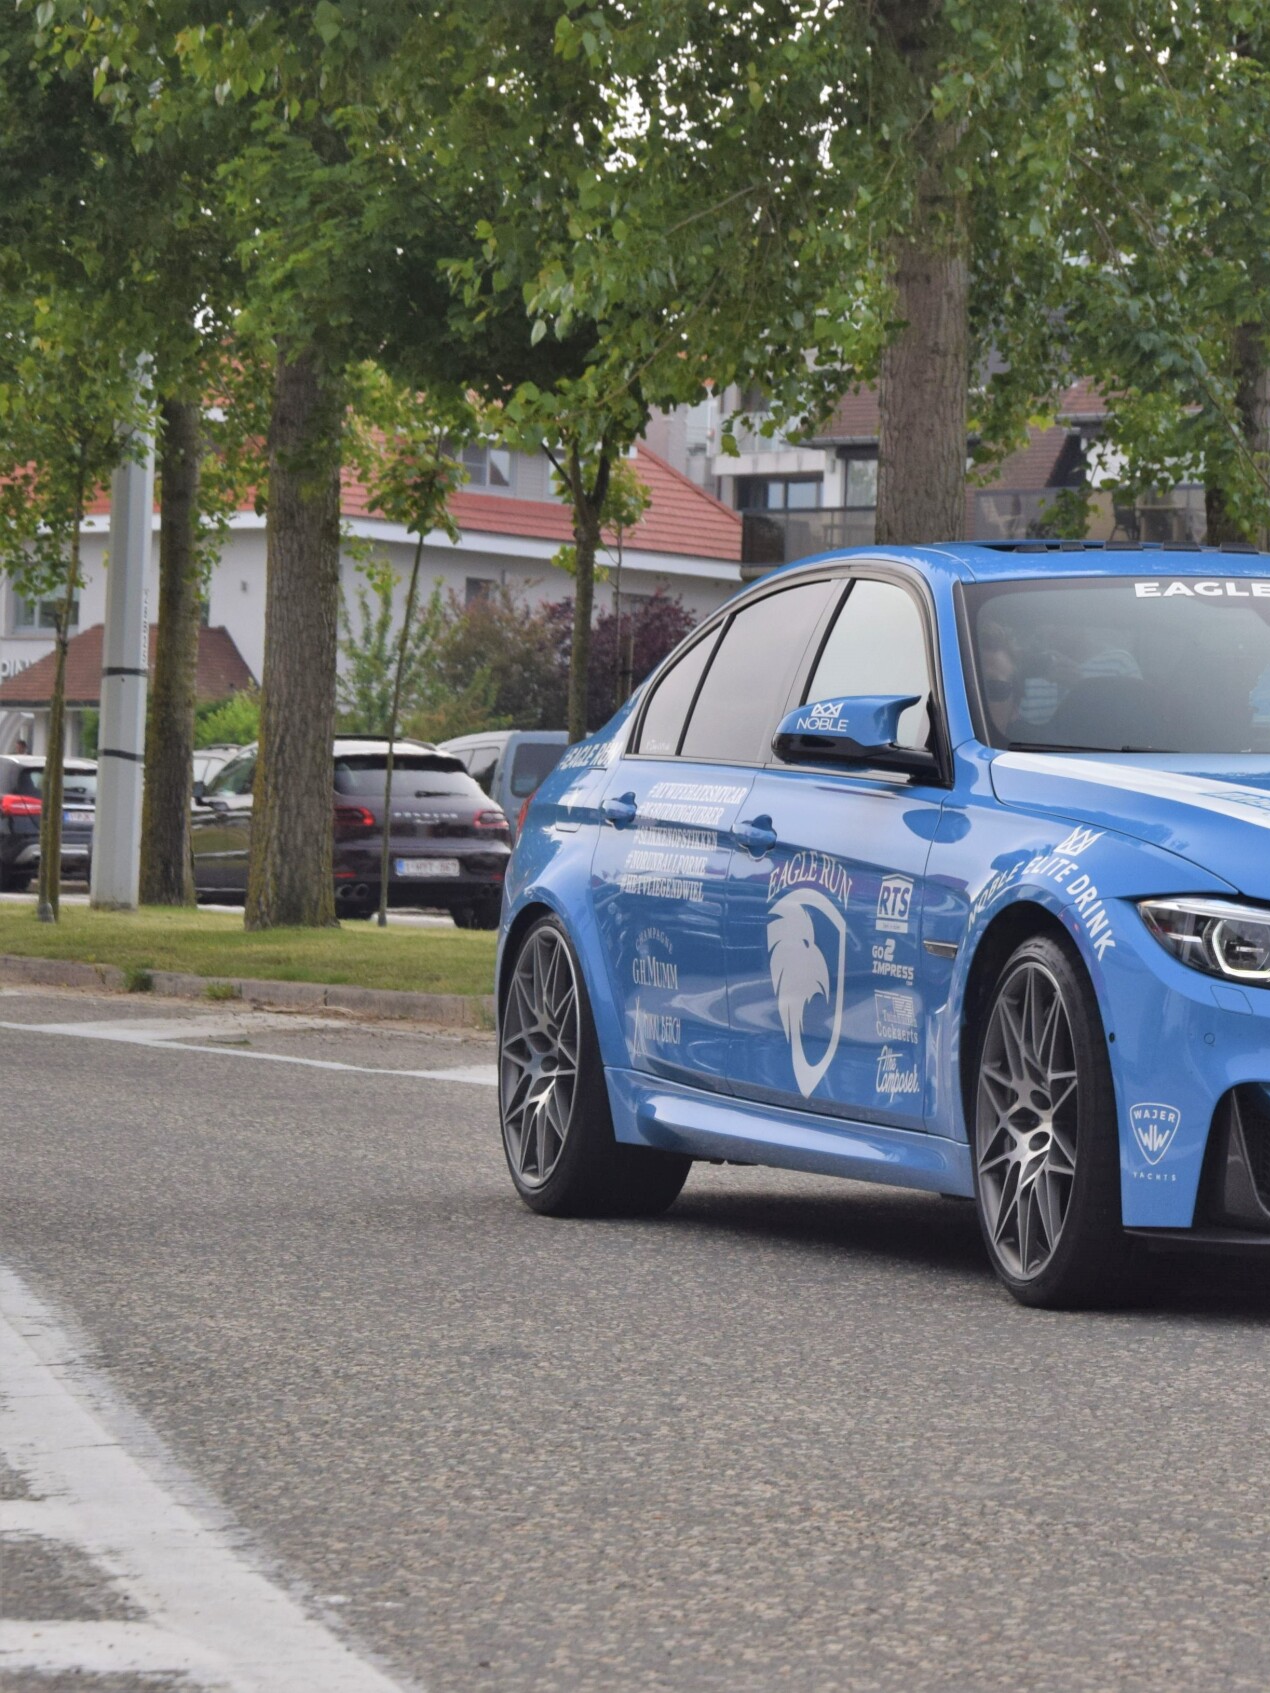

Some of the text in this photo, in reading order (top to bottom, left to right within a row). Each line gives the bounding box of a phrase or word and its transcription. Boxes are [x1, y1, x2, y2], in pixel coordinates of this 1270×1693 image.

[796, 717, 849, 732] NOBLE
[766, 850, 853, 911] EAGLE RUN
[879, 885, 911, 918] RTS
[1021, 855, 1079, 883] ELITE
[1066, 874, 1116, 962] DRINK
[635, 927, 673, 955] CHAMPAGNE
[872, 961, 914, 980] IMPRESS
[876, 1020, 918, 1044] Cockaerts
[1133, 1109, 1176, 1123] WAJER
[1133, 1171, 1177, 1182] YACHTS
